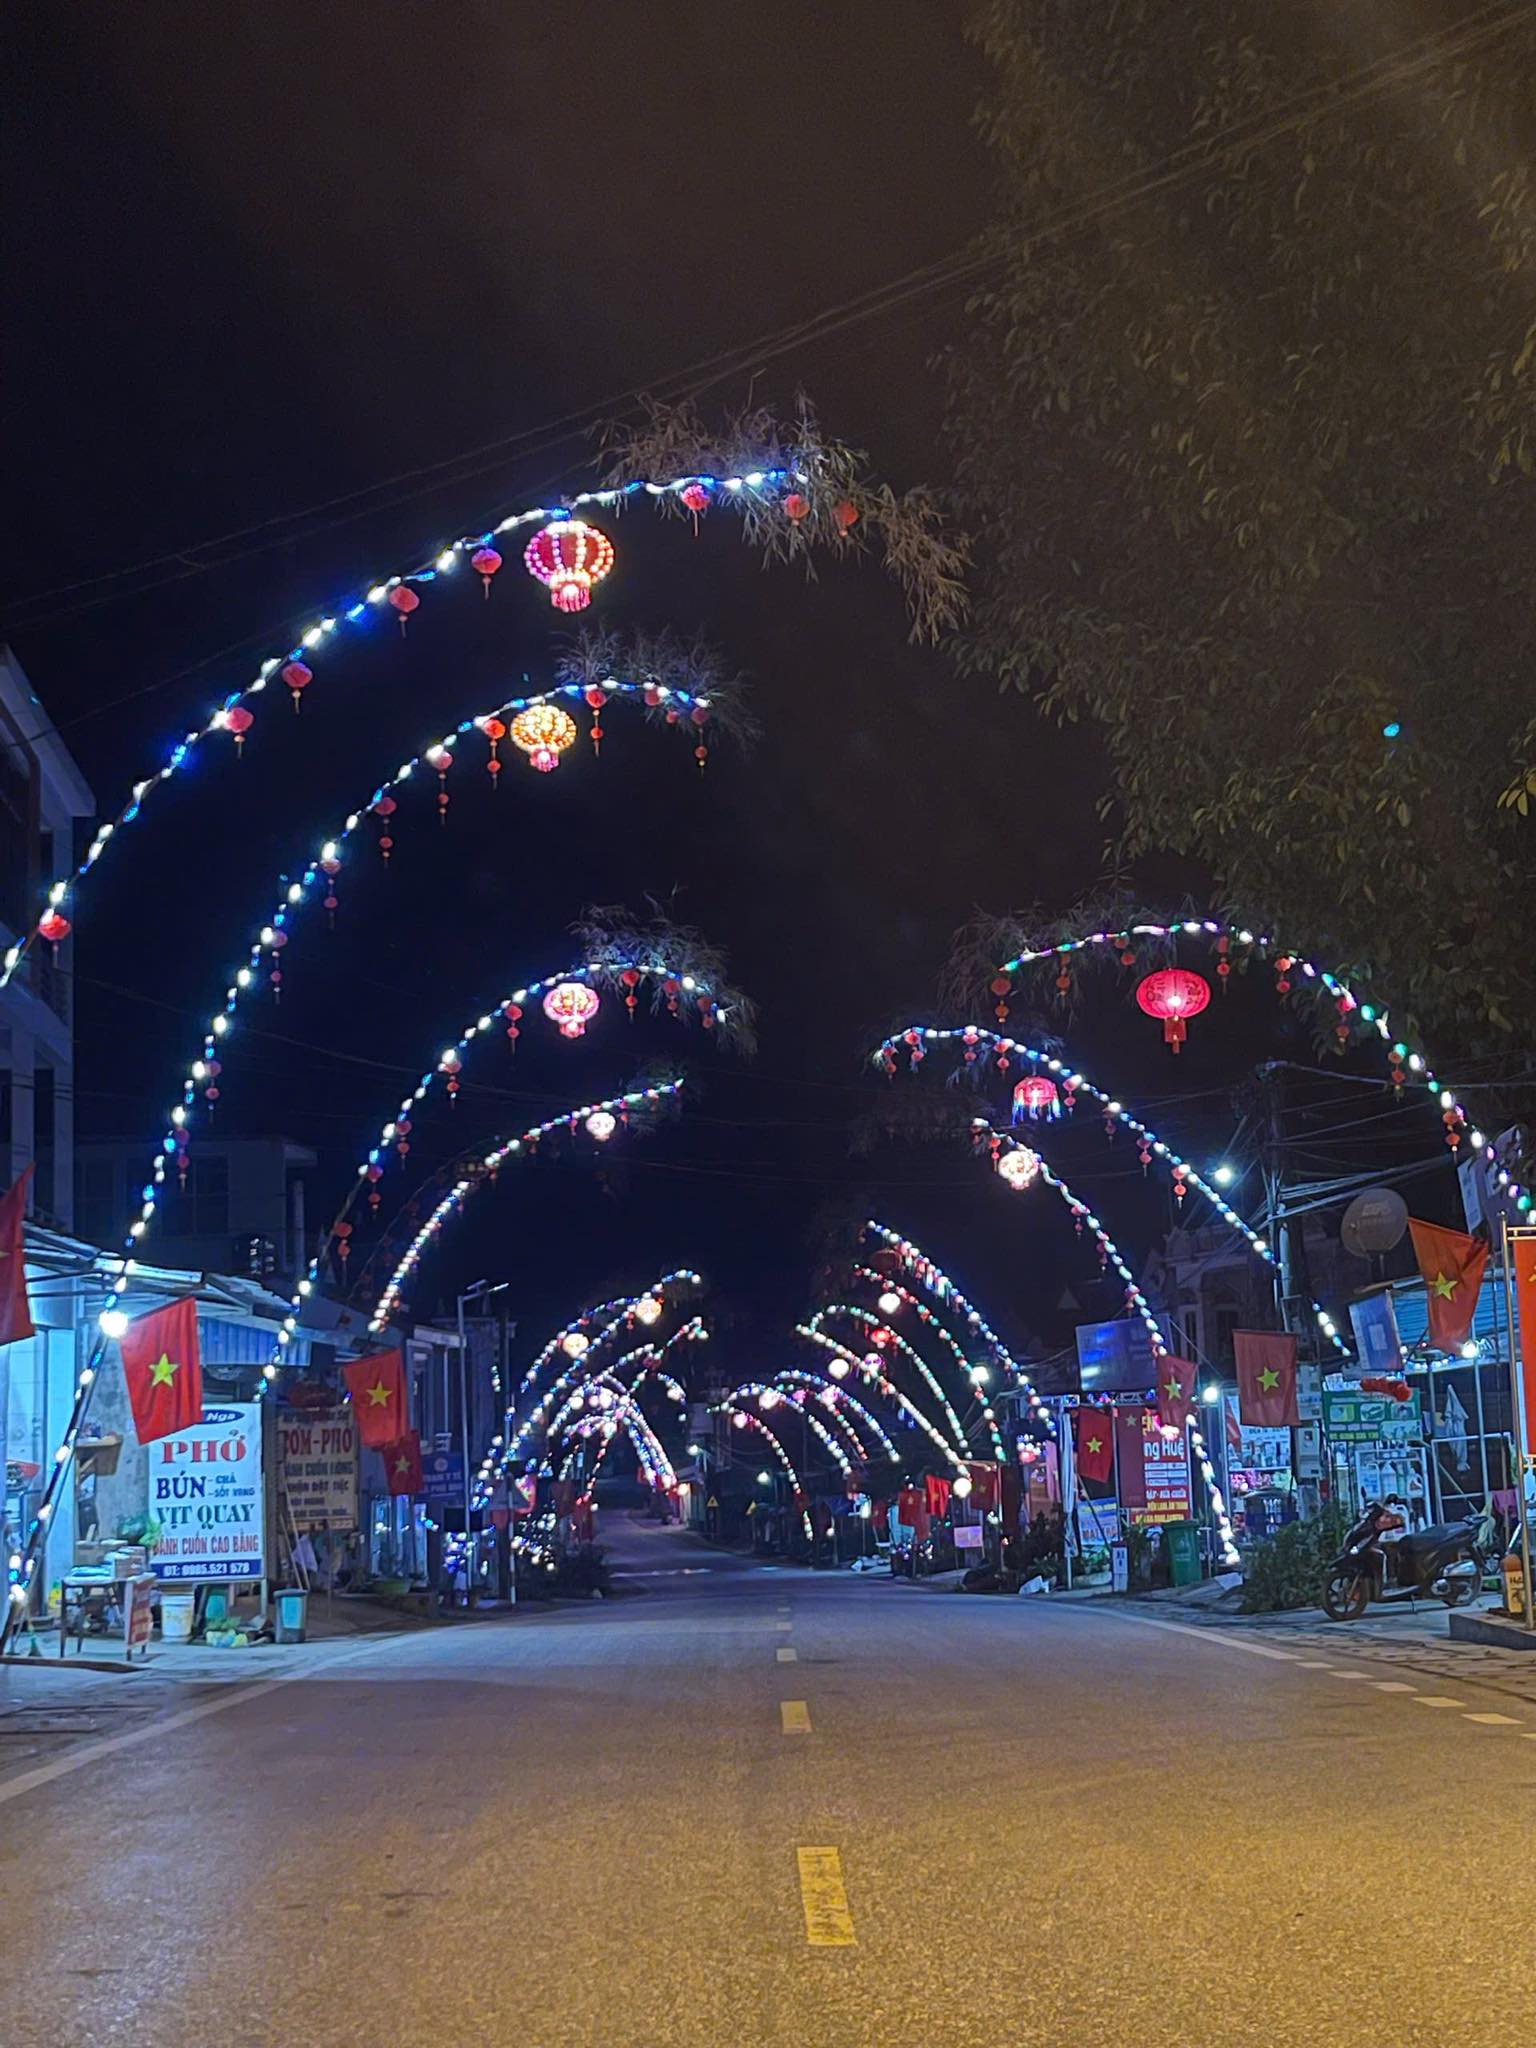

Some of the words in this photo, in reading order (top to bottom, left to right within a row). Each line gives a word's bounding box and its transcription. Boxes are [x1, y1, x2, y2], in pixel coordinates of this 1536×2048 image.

[206, 1412, 236, 1421] Nga
[161, 1429, 247, 1464] PHỞ
[1144, 1442, 1160, 1461] ng
[157, 1470, 207, 1499] BÚN
[215, 1472, 237, 1484] CHẢ
[156, 1505, 193, 1529] VỊT
[197, 1503, 256, 1530] QUAY
[182, 1530, 208, 1554] CUỐN
[211, 1536, 230, 1554] CAO
[232, 1528, 259, 1553] BẰNG
